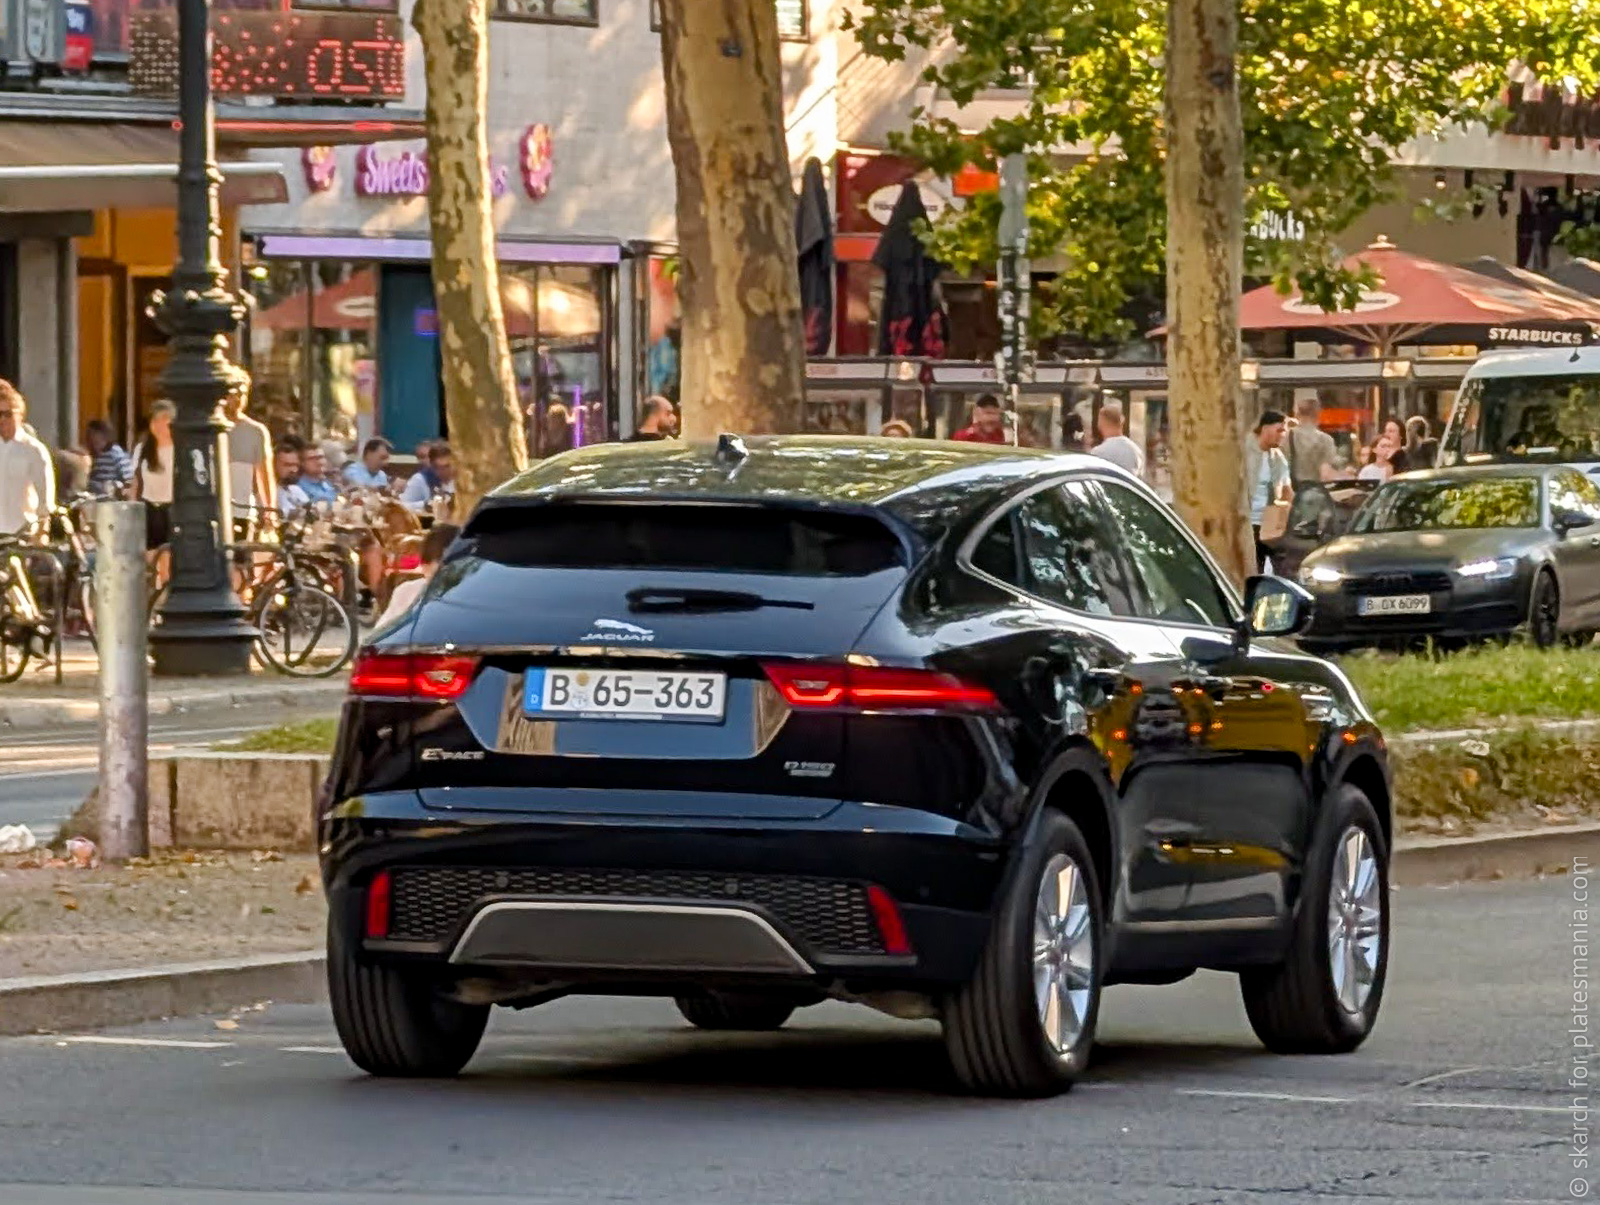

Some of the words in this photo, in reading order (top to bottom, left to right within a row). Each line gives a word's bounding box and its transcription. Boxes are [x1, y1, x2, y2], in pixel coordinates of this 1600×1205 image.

[1488, 327, 1583, 345] STARBUCKS
[580, 633, 655, 642] JAGUAR
[551, 674, 570, 706] B
[593, 674, 716, 709] 65-363
